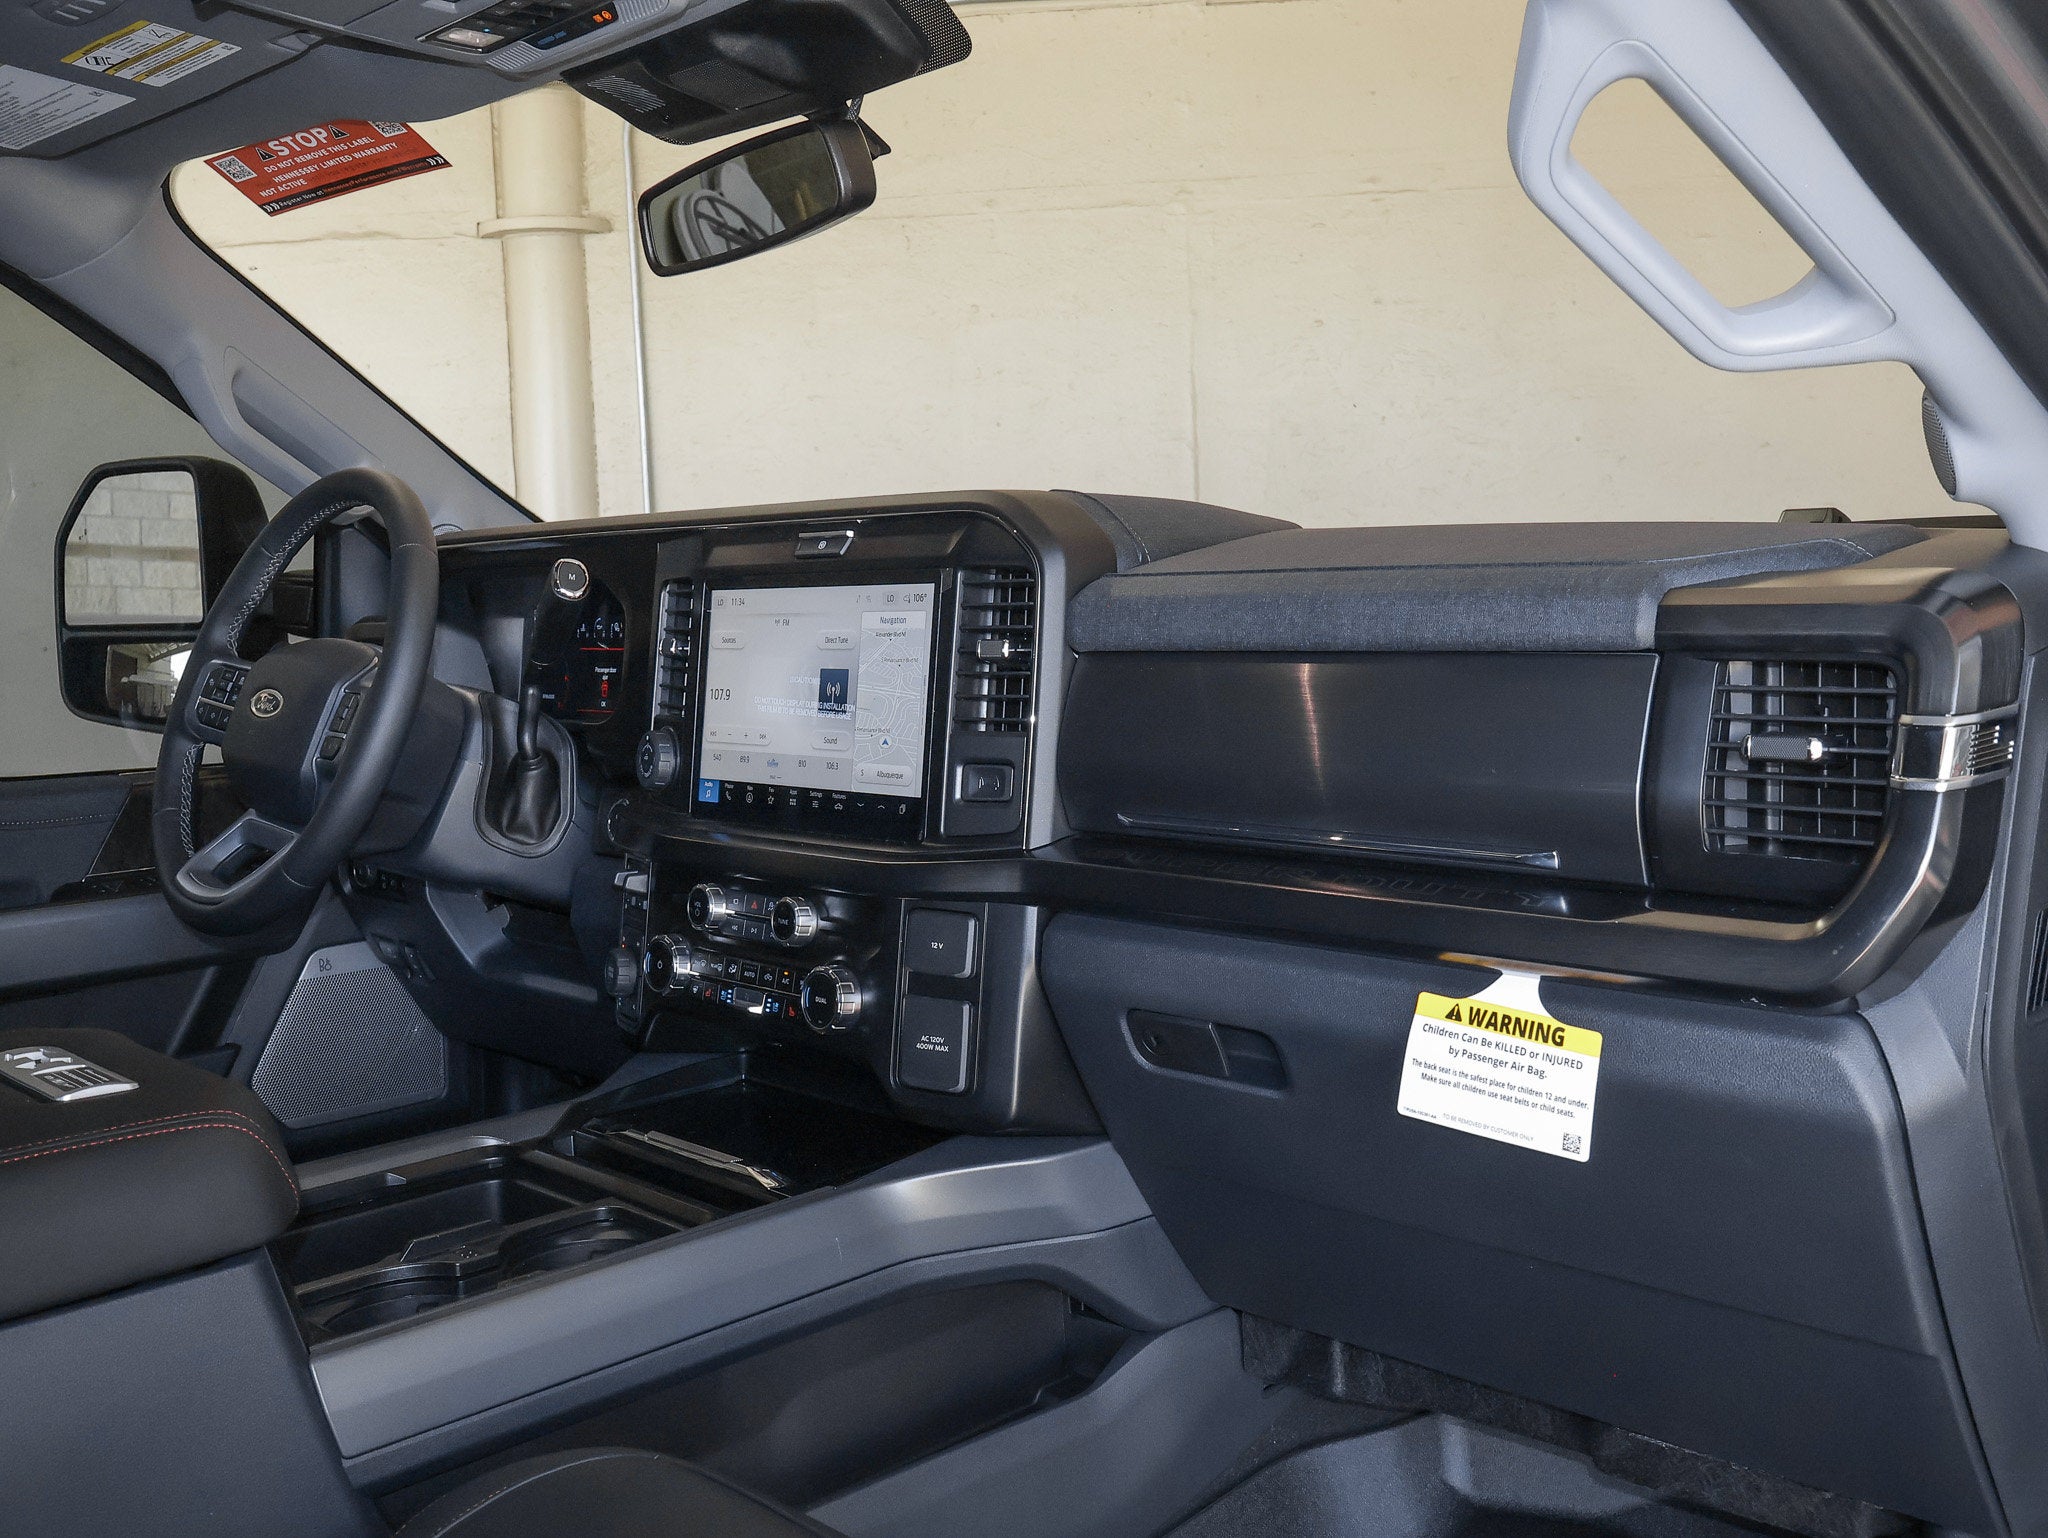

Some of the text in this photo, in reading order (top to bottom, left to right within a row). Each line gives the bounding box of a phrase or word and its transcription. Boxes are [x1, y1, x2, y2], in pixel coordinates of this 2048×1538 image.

[268, 128, 329, 156] STOP
[264, 137, 376, 174] DO NOT REMOVE THIS LABEL
[272, 165, 320, 184] HENNESSEY
[320, 156, 353, 170] LIMITED
[352, 142, 398, 161] WARRANTY
[259, 178, 308, 198] NOT ACTIVE
[279, 195, 302, 207] Register
[302, 191, 317, 201] Now
[731, 598, 746, 606] 11:34
[886, 594, 895, 602] LO
[782, 618, 790, 626] FM
[880, 616, 907, 626] Navigation
[721, 636, 737, 644] Sources
[824, 636, 849, 644] Direct Tune
[710, 688, 731, 700] 107.9
[823, 702, 856, 712] INSTALLATION
[818, 710, 834, 718] BEFORE
[823, 736, 838, 745] Sound
[798, 760, 807, 768] 810
[876, 770, 904, 780] Albuquerque
[810, 790, 823, 798] Settings
[938, 942, 944, 950] V
[744, 971, 756, 979] AUTO
[782, 978, 790, 986] A/C
[814, 996, 827, 1005] DUAL
[1468, 1006, 1566, 1047] WARNING
[920, 1035, 945, 1044] AC 120V
[916, 1042, 950, 1052] 400W MAX
[1422, 1023, 1584, 1070] Children Can Be KILLED or INJURED
[1448, 1045, 1548, 1080] by Passenger Air Bag.
[1412, 1058, 1590, 1110] The back seat is the safest place for children 12 and under.
[1420, 1072, 1576, 1118] Make sure all children use seat belts or child seats.
[1442, 1112, 1450, 1120] TO
[1458, 1117, 1482, 1128] REMOVED
[1490, 1126, 1519, 1138] CUSTOMER
[1520, 1132, 1534, 1142] ONLY
